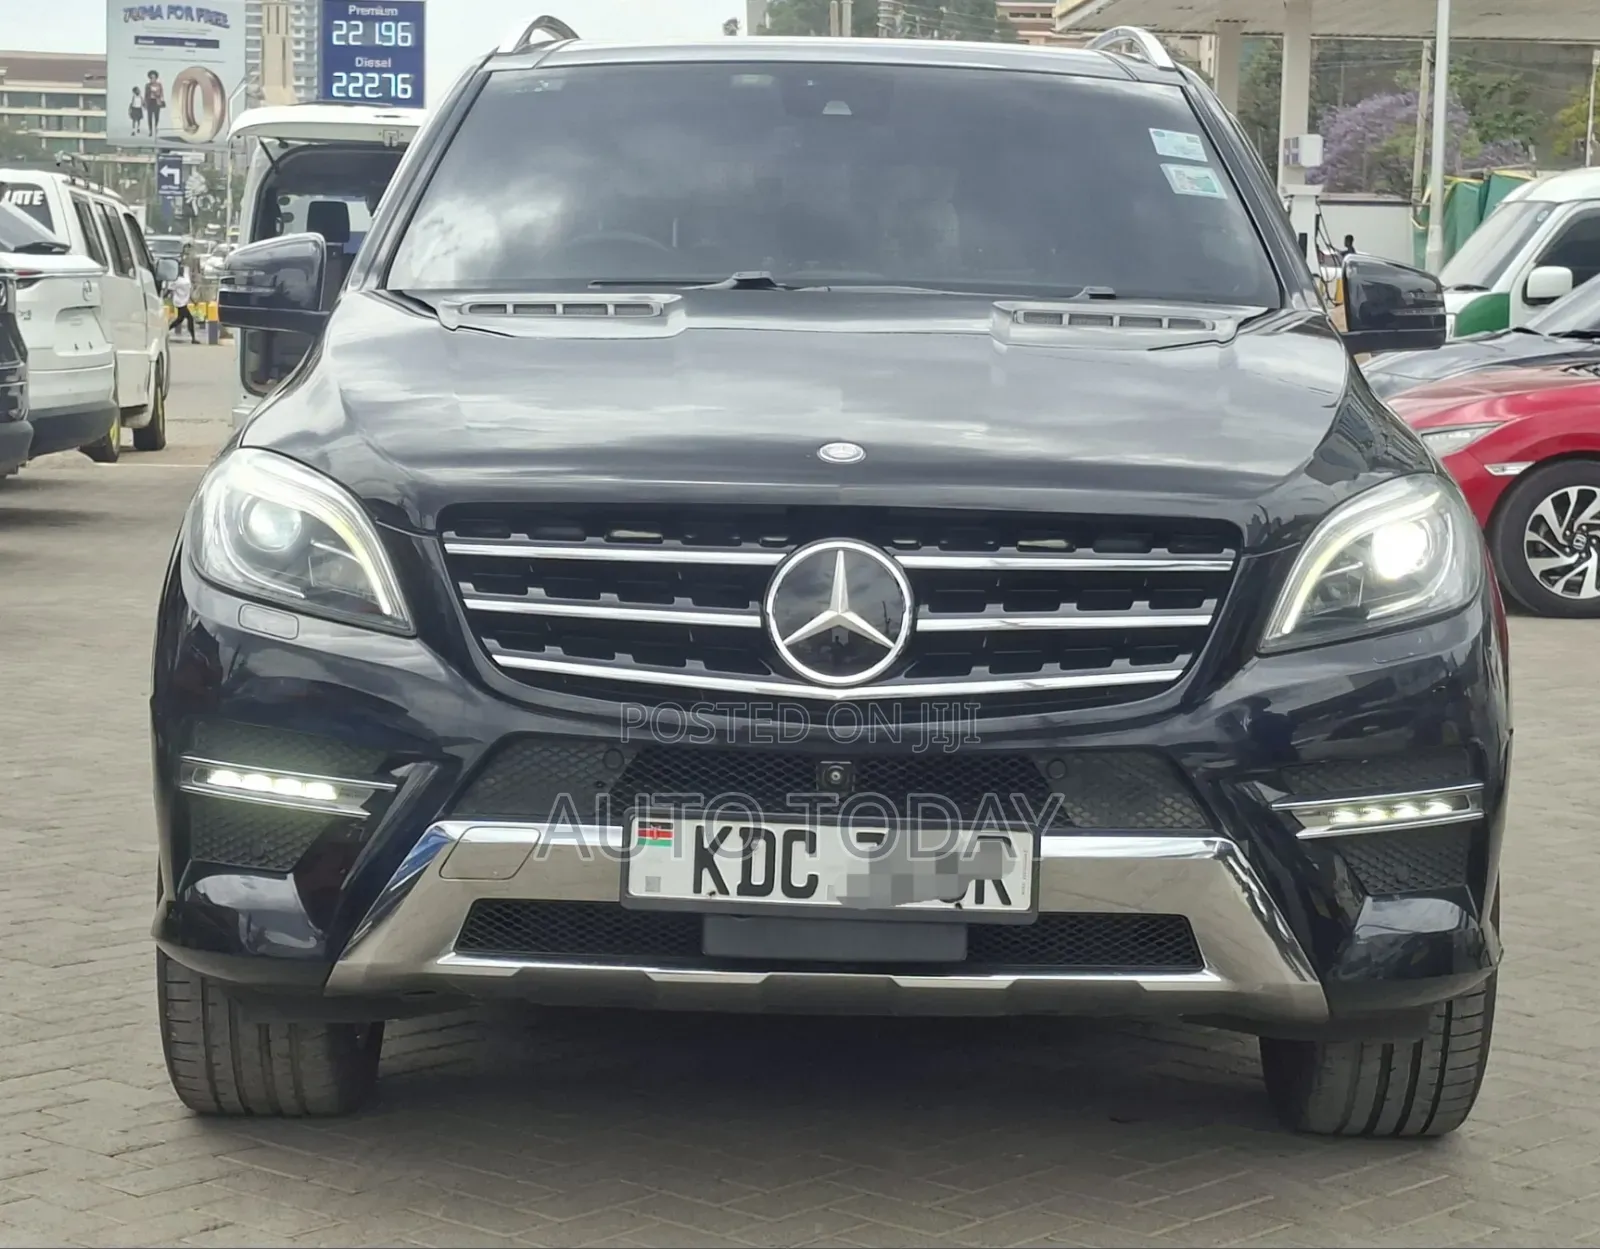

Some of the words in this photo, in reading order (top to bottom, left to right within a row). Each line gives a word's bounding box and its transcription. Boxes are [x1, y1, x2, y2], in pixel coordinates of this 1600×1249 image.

[166, 4, 194, 22] FOR
[348, 4, 399, 16] Premium
[355, 56, 392, 68] Diesel
[692, 824, 820, 899] KDC
